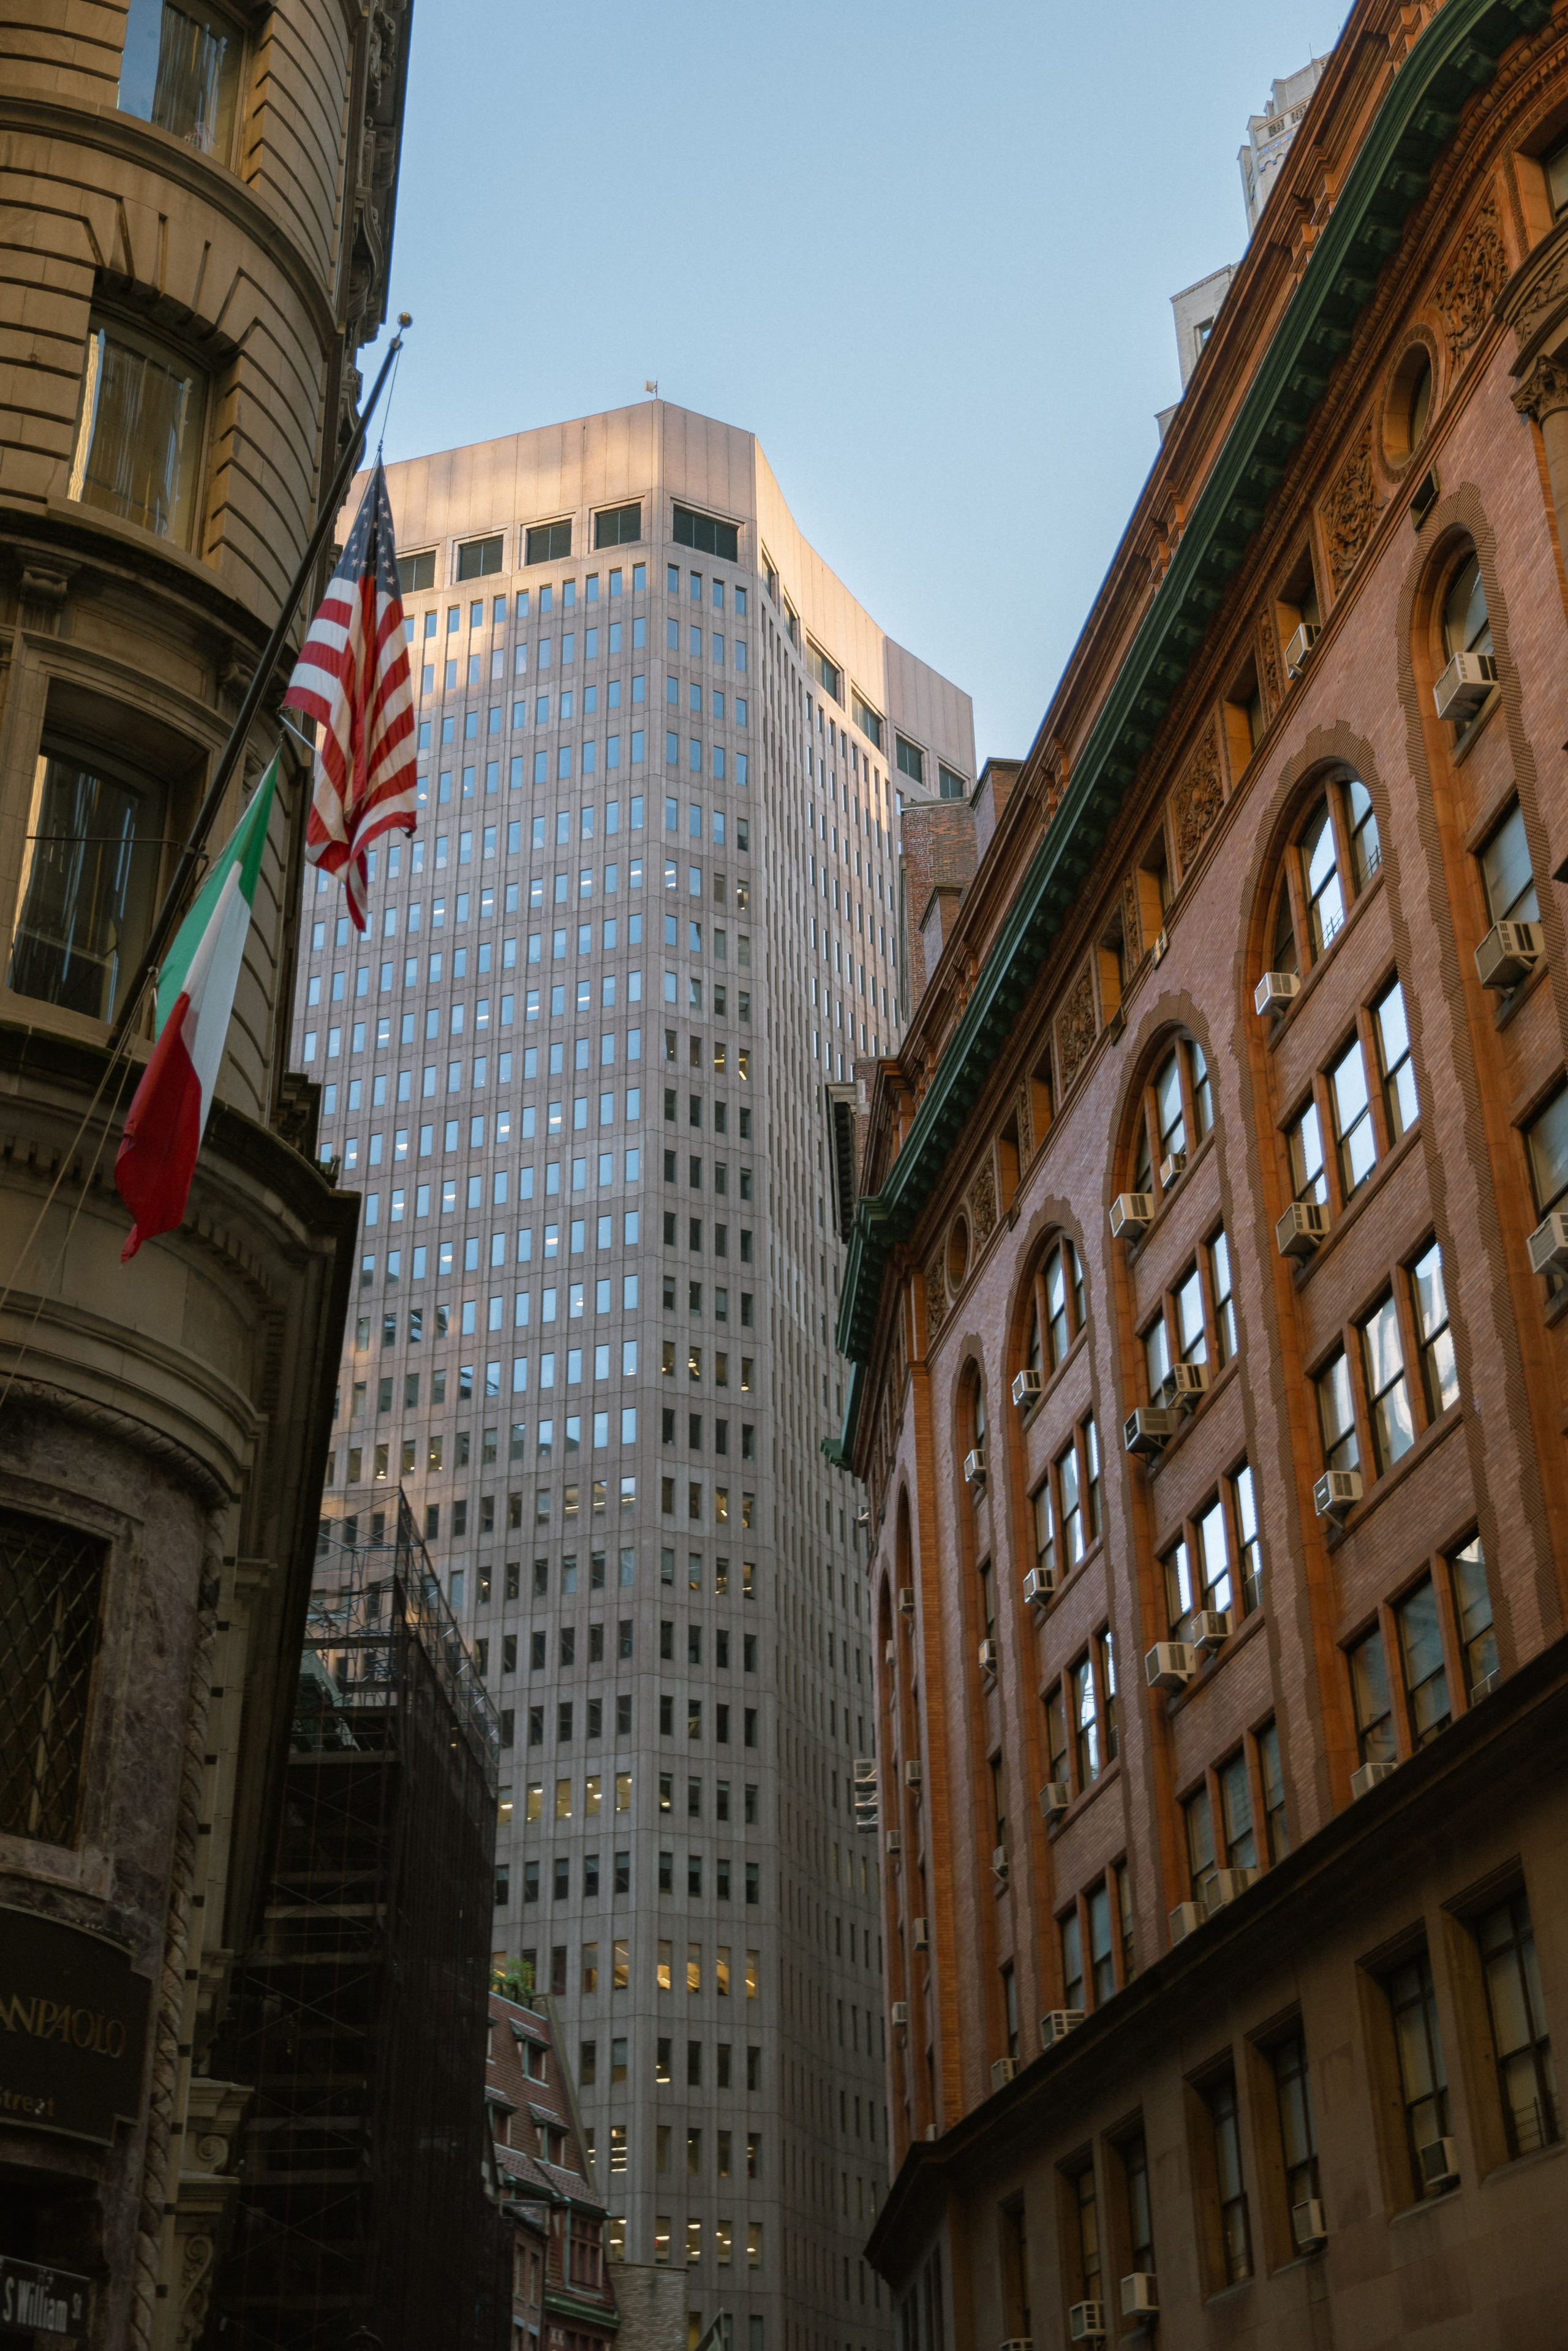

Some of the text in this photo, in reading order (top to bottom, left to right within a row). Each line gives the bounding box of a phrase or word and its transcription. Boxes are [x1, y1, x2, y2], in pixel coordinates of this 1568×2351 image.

[0, 2086, 56, 2117] tret
[2, 2276, 15, 2322] S
[17, 2279, 69, 2333] William
